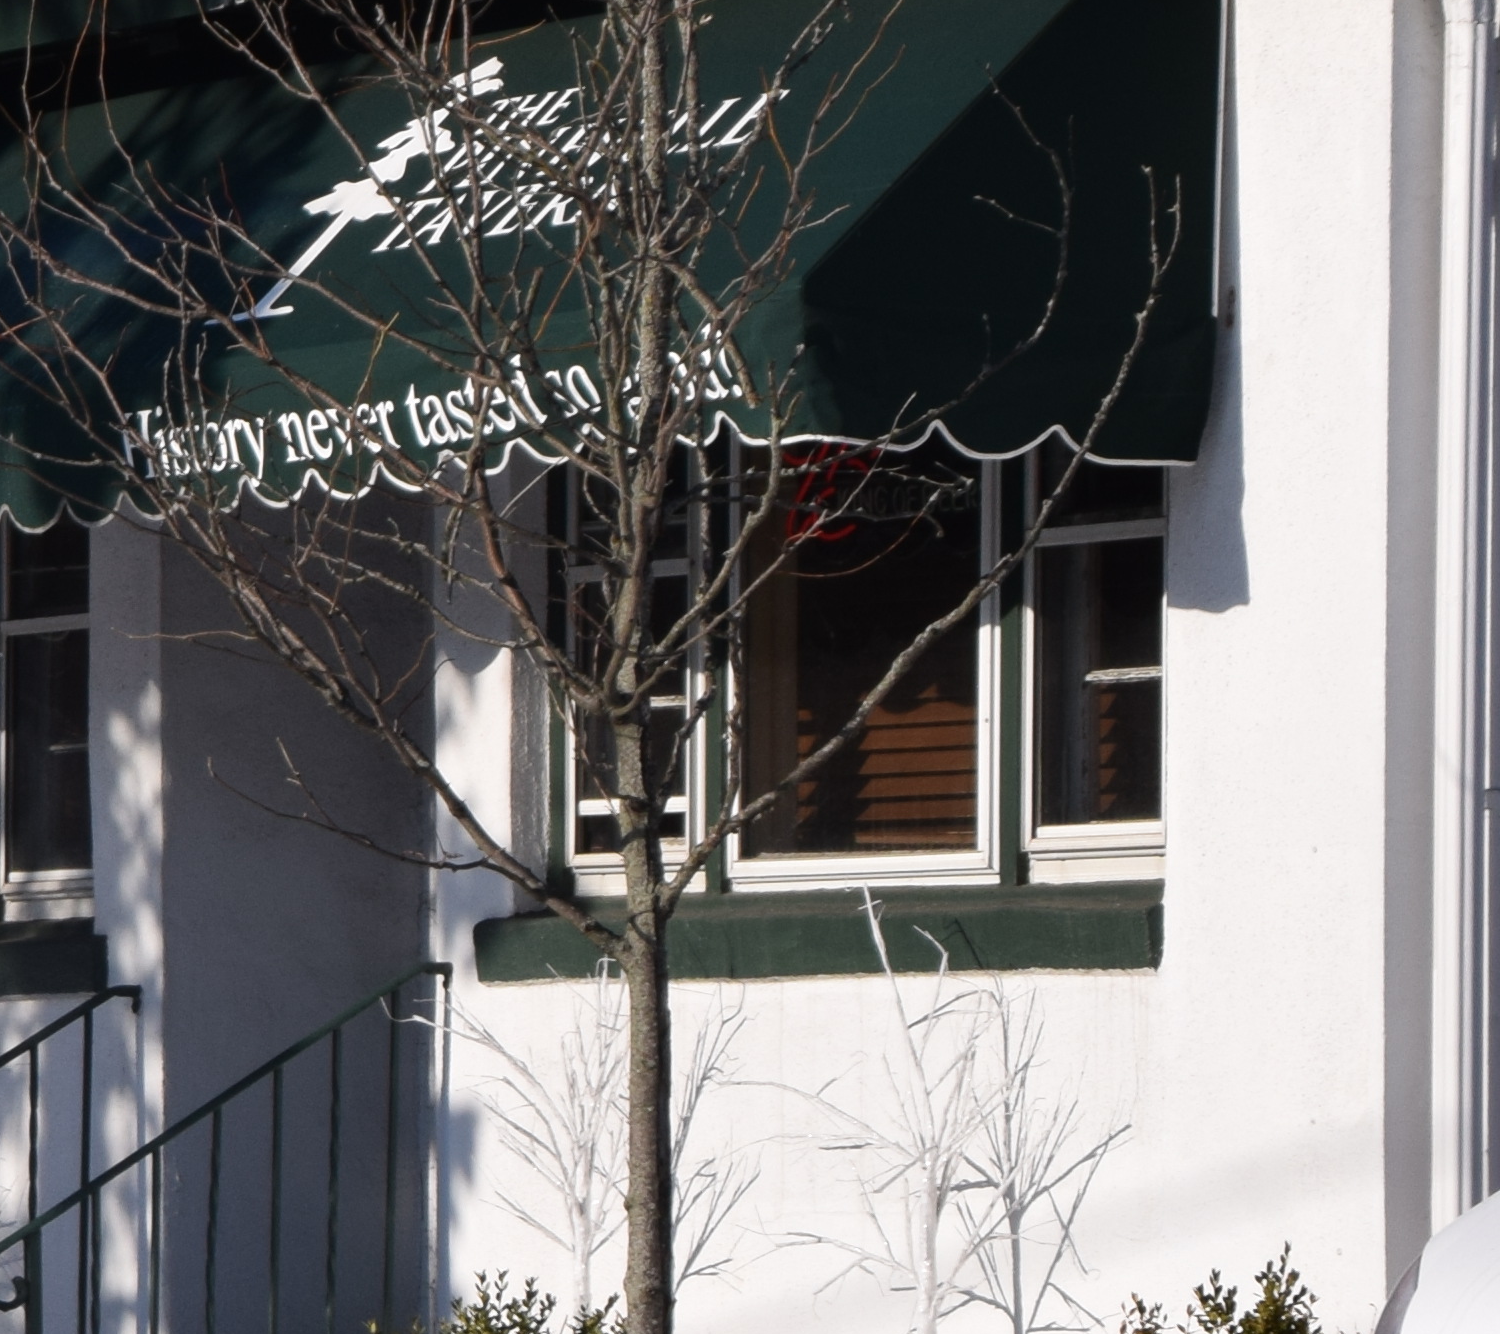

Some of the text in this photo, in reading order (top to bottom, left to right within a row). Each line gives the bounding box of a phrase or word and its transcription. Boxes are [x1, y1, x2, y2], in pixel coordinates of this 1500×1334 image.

[474, 86, 585, 137] THE
[123, 405, 265, 488] History
[277, 398, 401, 464] never
[404, 353, 548, 448] tasted
[545, 364, 603, 419] so
